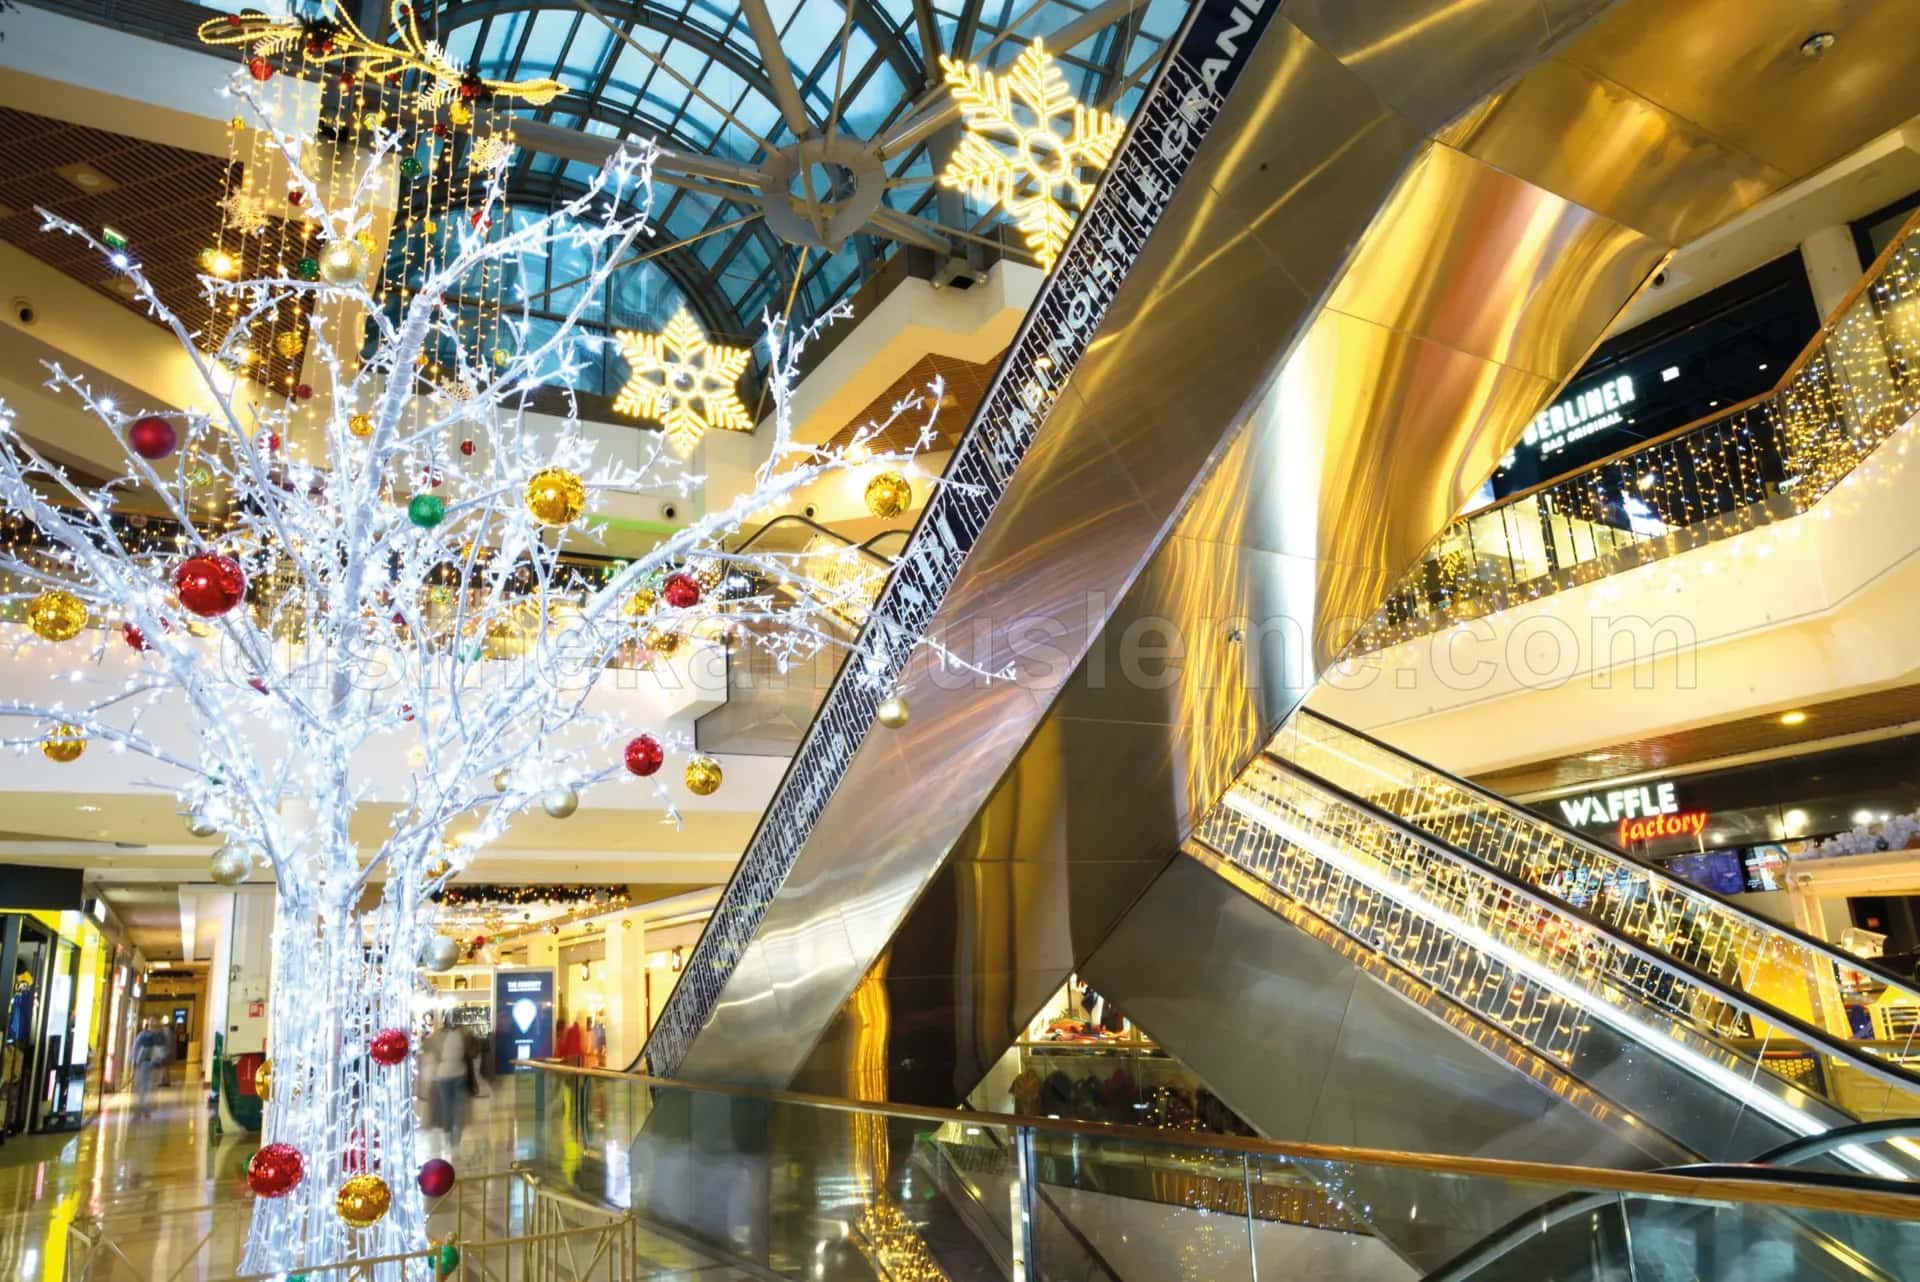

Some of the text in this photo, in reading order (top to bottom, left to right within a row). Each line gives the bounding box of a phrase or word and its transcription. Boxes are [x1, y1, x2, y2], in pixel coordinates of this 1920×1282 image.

[1048, 223, 1128, 367] NOISY
[1127, 165, 1164, 222] LE
[1541, 411, 1624, 454] DAS ORIGINAL
[1560, 782, 1680, 827] WAFFLE
[1618, 810, 1709, 849] factory
